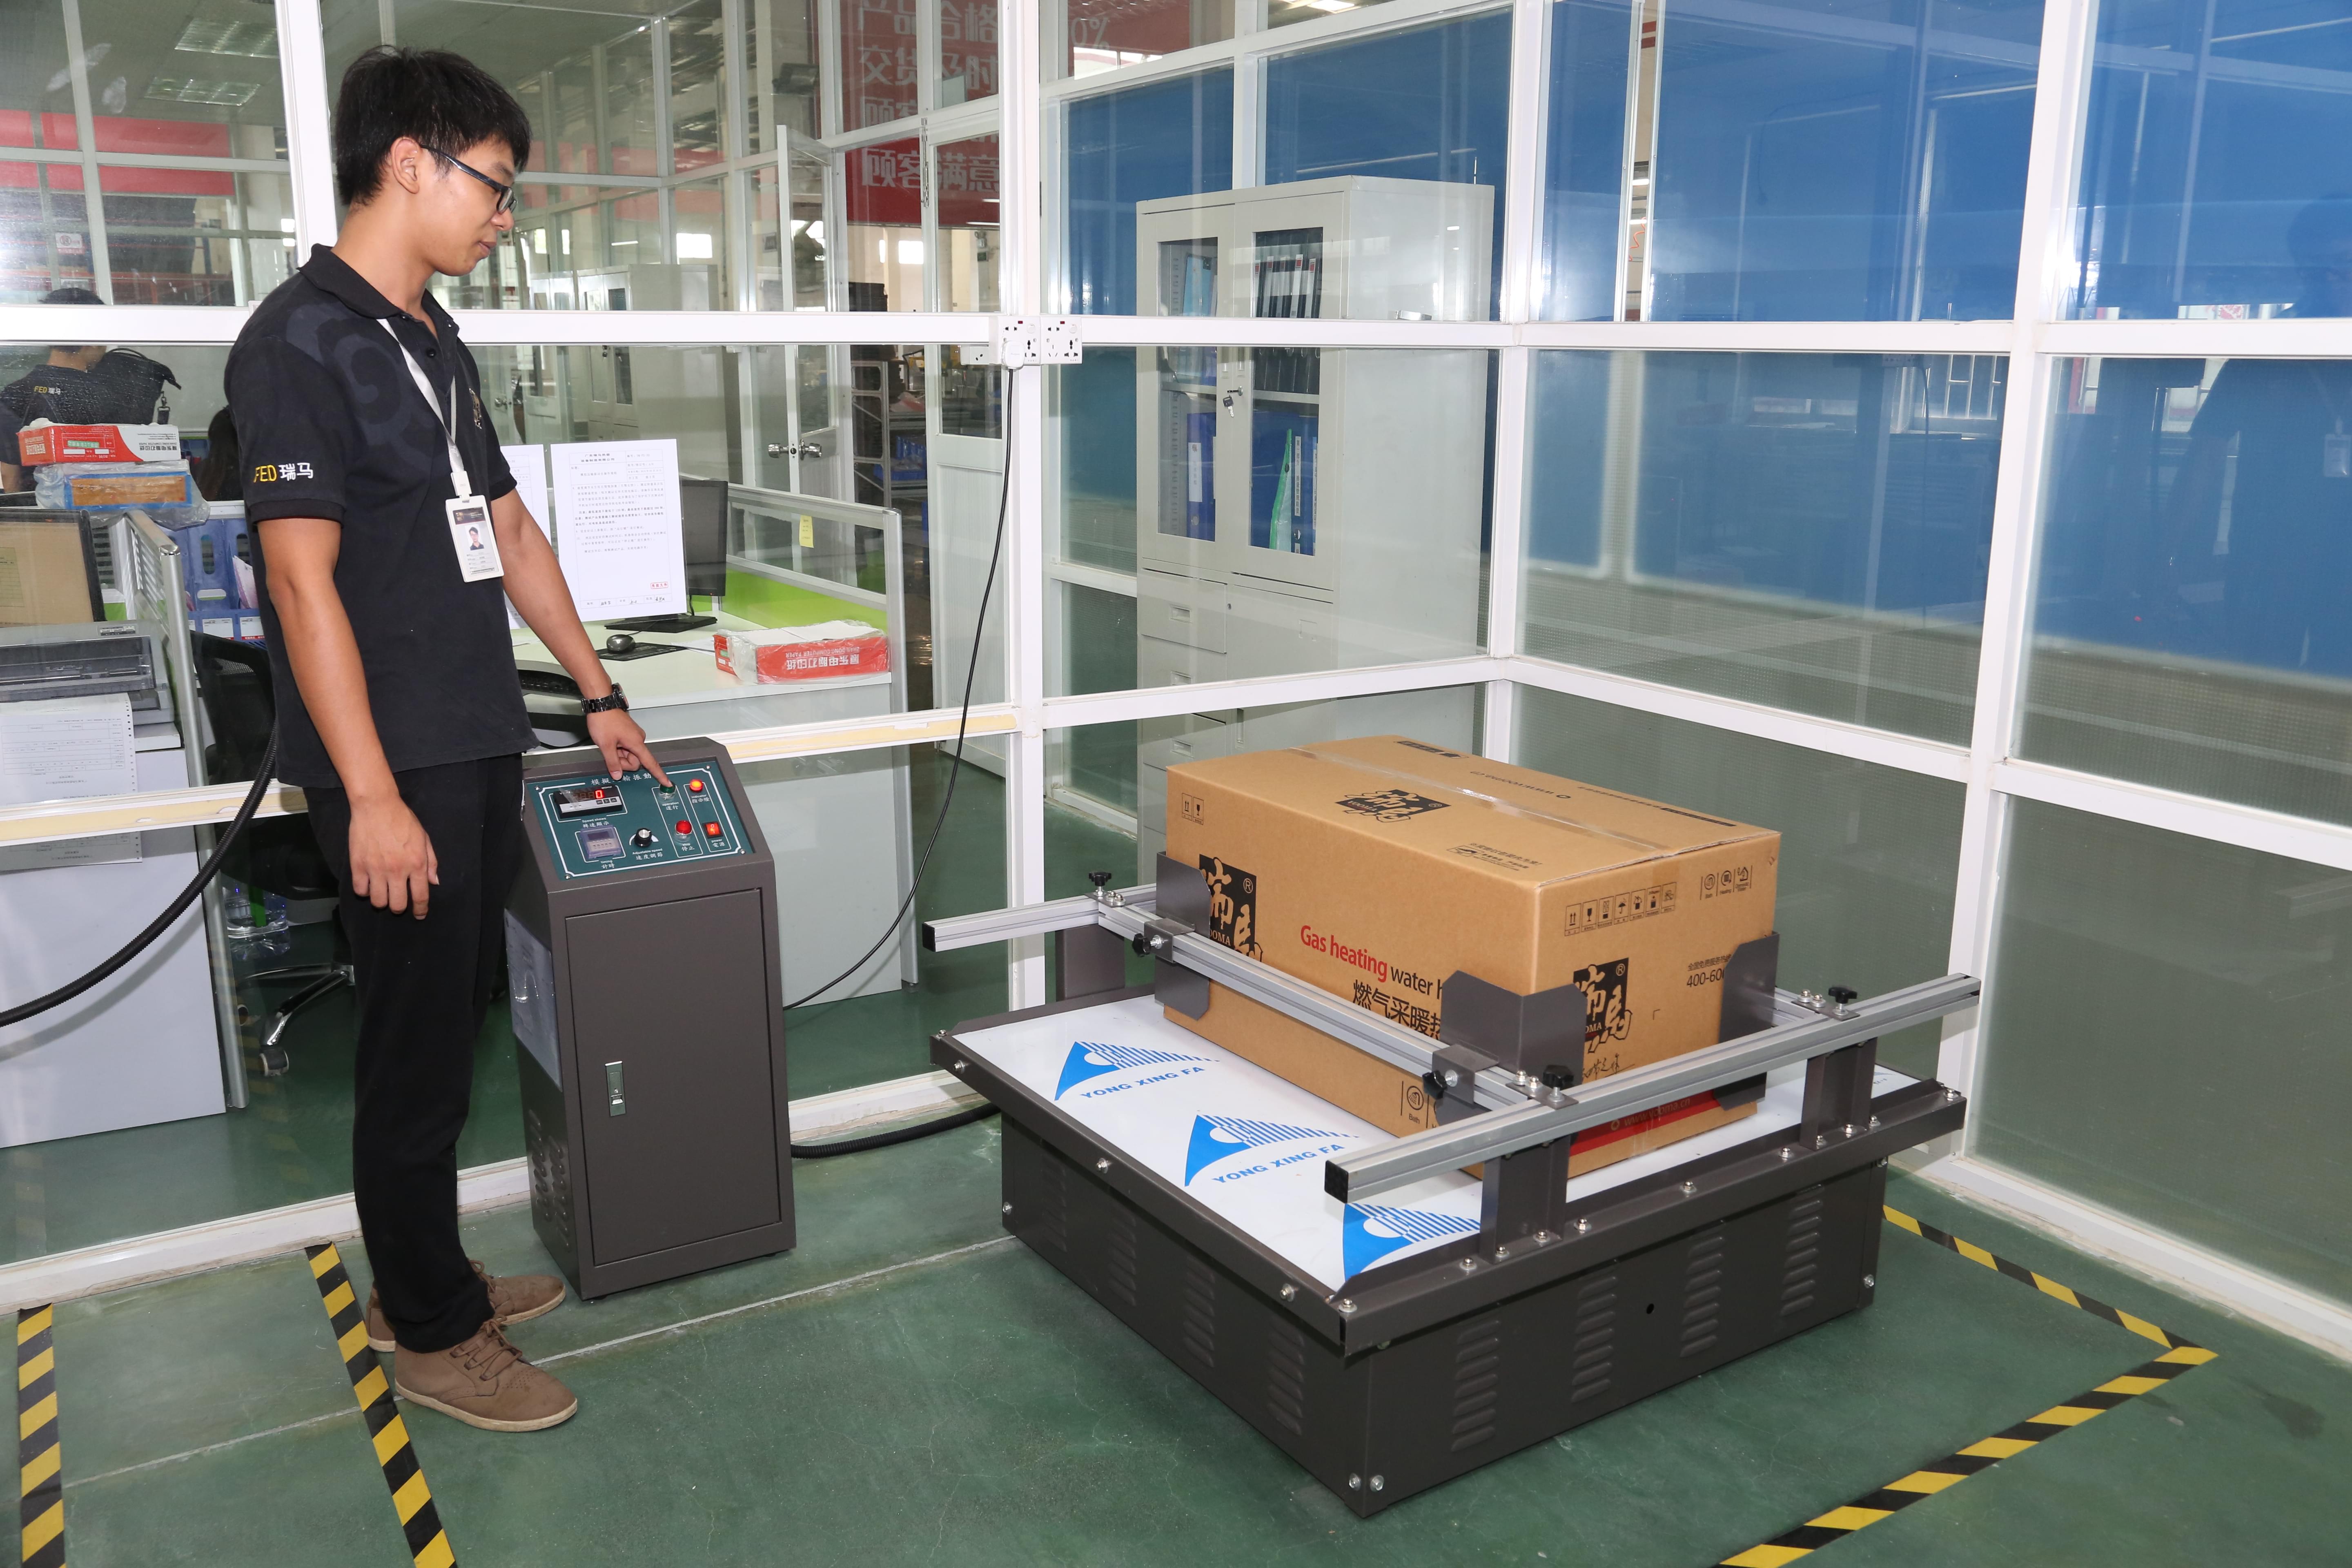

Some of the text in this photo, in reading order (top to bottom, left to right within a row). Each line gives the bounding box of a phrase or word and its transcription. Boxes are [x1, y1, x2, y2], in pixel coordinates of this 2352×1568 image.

[862, 148, 999, 192] 顾客满意
[33, 385, 48, 394] FED
[253, 462, 314, 483] FED 瑞马
[786, 654, 860, 670] 展东电脑打印纸
[590, 772, 652, 786] 模擬輸振動
[1346, 800, 1378, 812] VOOMA
[1300, 925, 1327, 953] Gas
[1330, 934, 1388, 983] heating
[1390, 966, 1433, 996] water
[1686, 968, 1725, 988] 400-60
[1080, 1066, 1206, 1099] YONG XING FA
[1408, 1113, 1421, 1125] Bath
[1211, 1144, 1346, 1184] YONG XING FA
